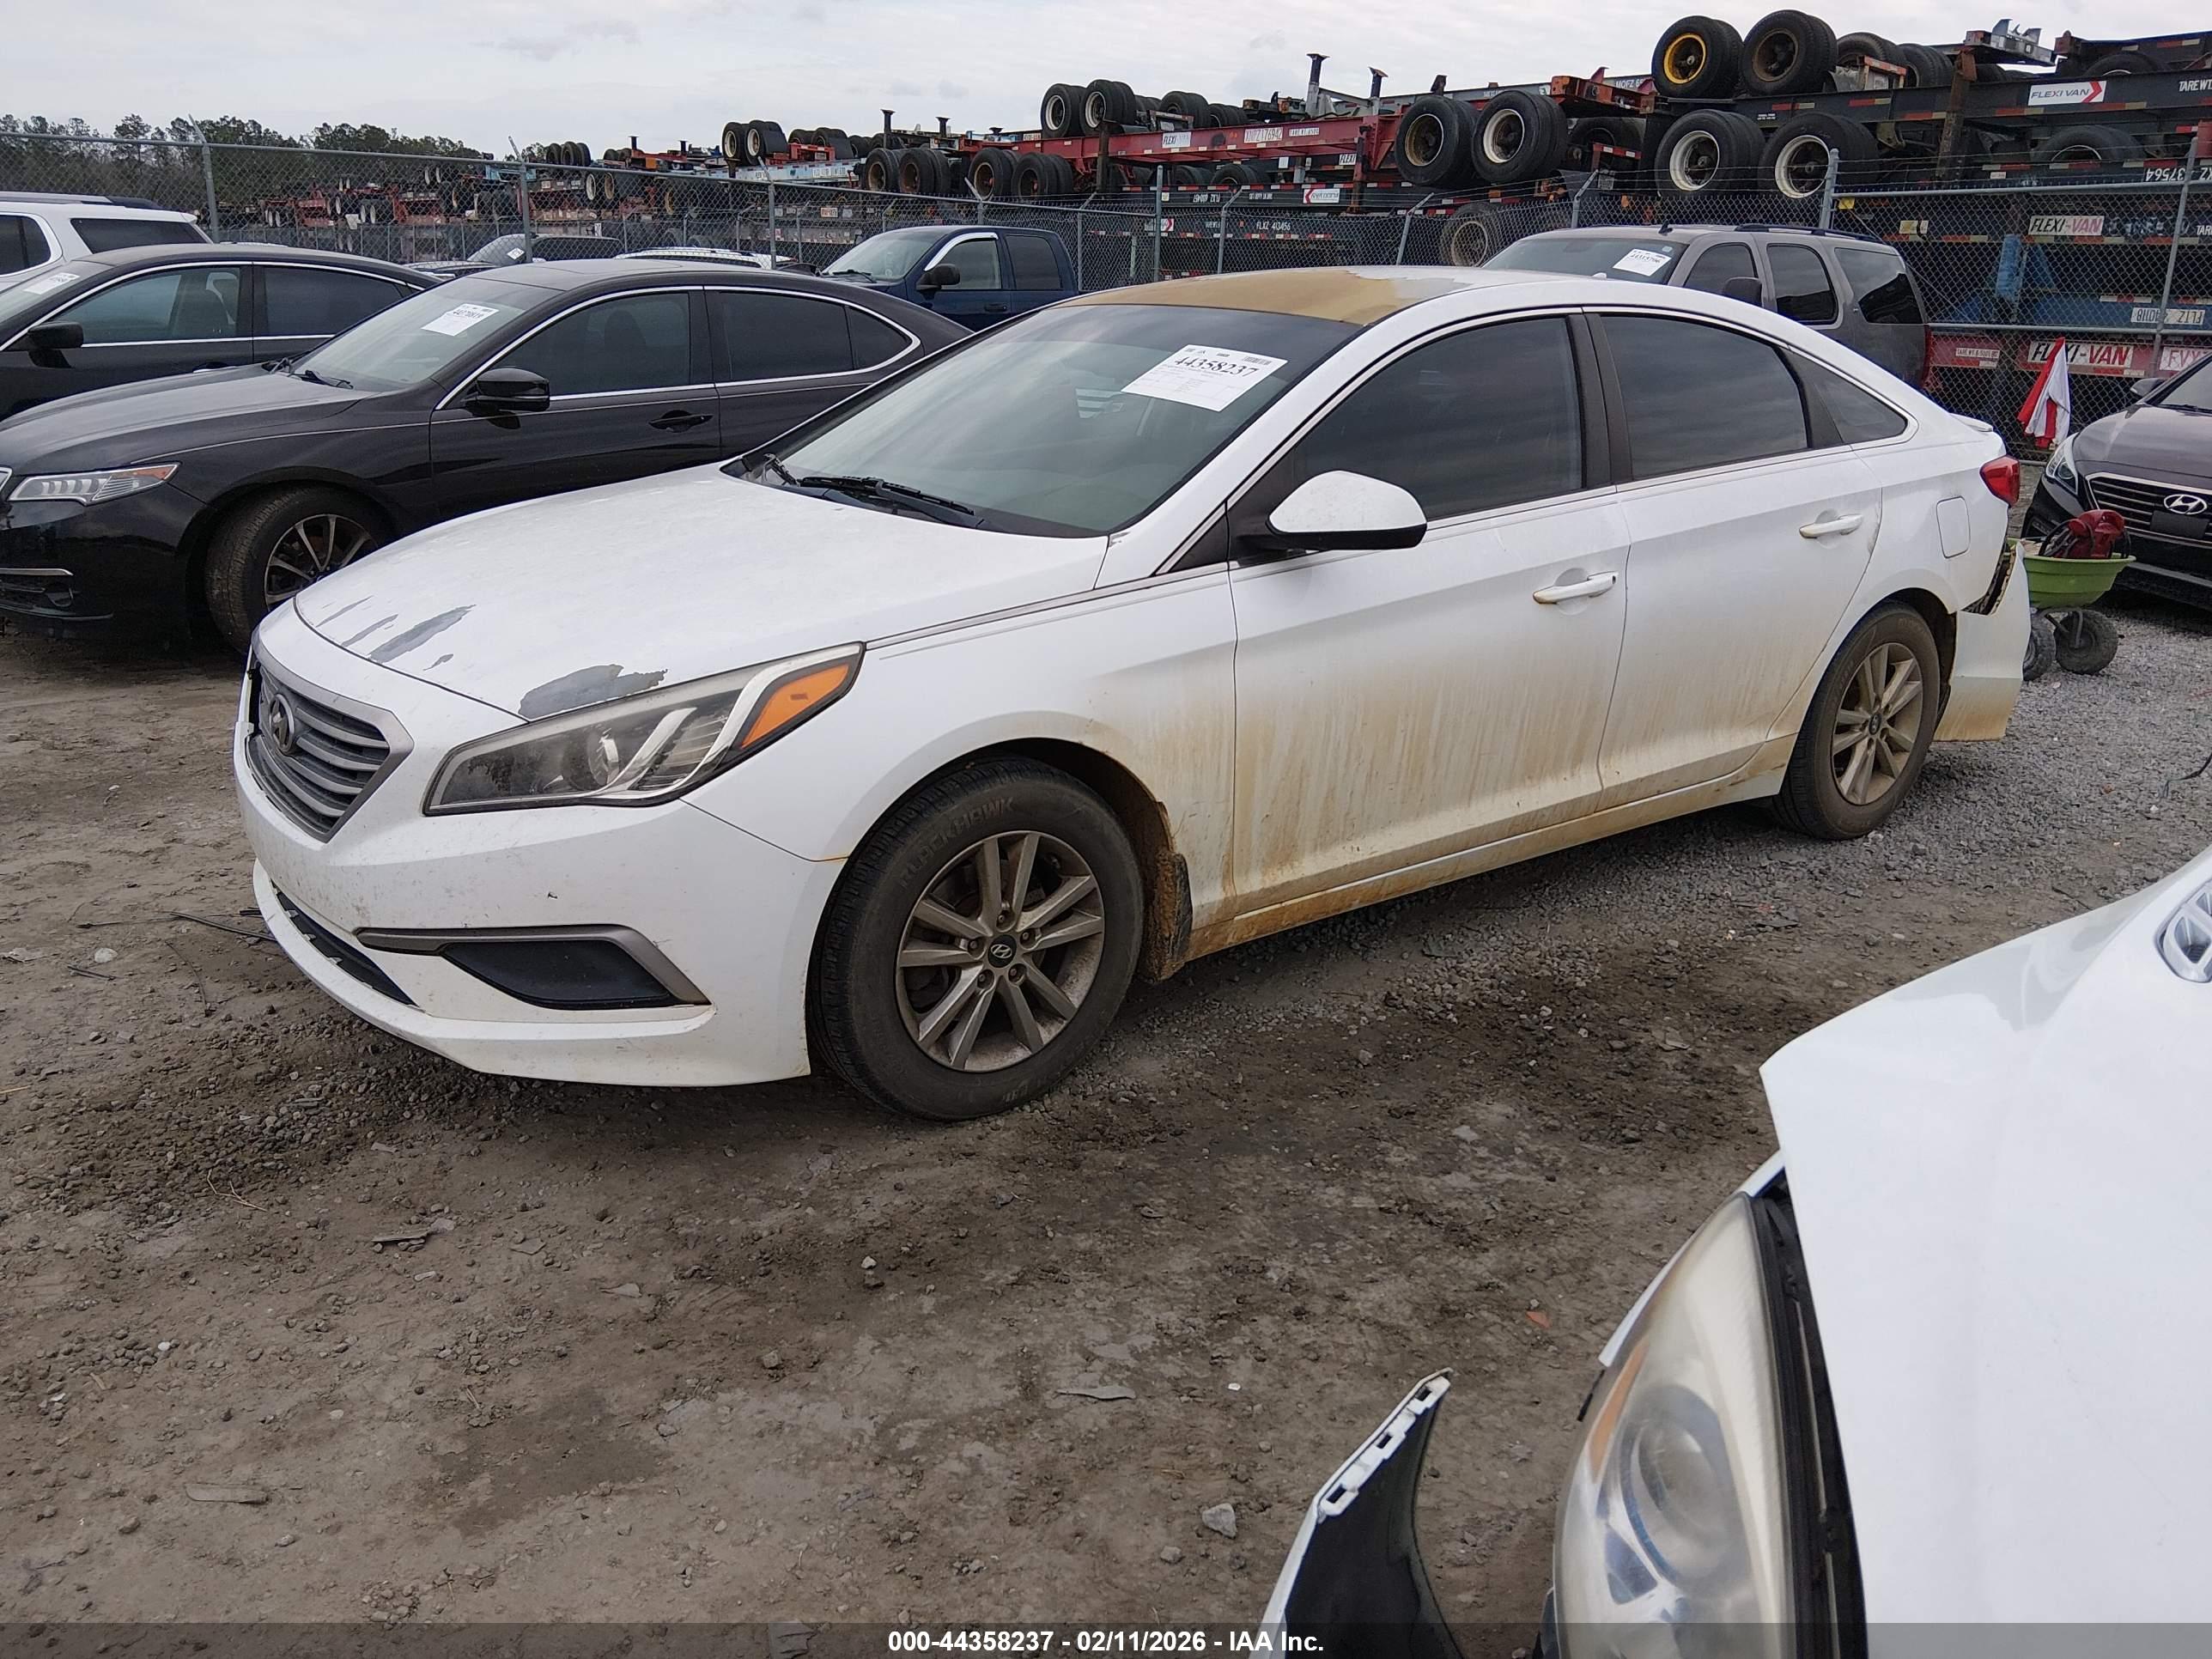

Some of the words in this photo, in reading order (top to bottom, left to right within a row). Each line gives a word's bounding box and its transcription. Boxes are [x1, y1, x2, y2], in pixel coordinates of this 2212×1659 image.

[2031, 89, 2064, 100] FLEXI
[2065, 88, 2089, 96] VAN
[2145, 167, 2193, 182] 37564
[1175, 356, 1260, 377] 44358237
